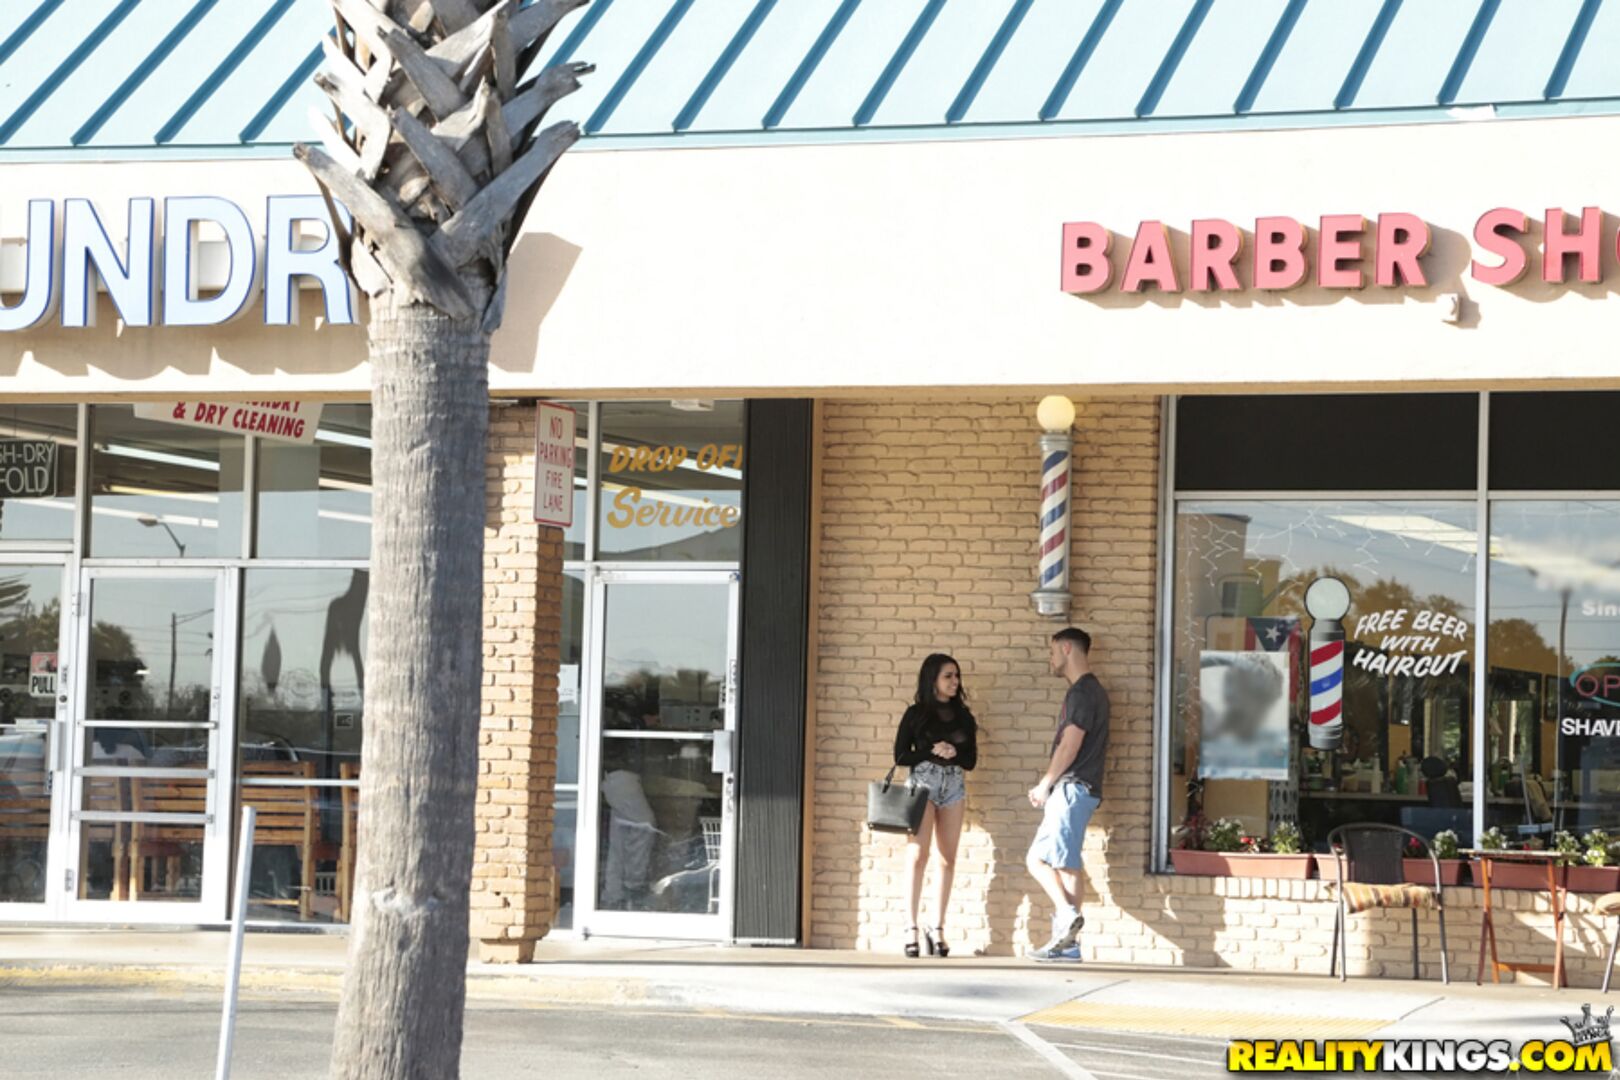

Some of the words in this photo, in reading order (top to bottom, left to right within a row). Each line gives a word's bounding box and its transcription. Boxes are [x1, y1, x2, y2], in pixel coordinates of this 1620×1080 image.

[1060, 211, 1431, 292] BARBER
[1470, 206, 1620, 285] SH
[172, 401, 186, 419] &
[194, 402, 229, 426] DRY
[232, 408, 305, 438] CLEANING
[549, 415, 563, 439] NO
[0, 443, 55, 464] H-DRY
[539, 440, 574, 469] PARKING
[607, 444, 688, 473] DROP
[545, 469, 563, 489] FIRE
[543, 492, 563, 513] LANE
[606, 486, 741, 529] Service
[1582, 600, 1620, 617] Sin
[1353, 608, 1408, 640] FREE
[1411, 610, 1468, 642] BEER
[1380, 634, 1440, 652] WITH
[1352, 649, 1468, 678] HAIRCUT
[31, 674, 56, 694] PULL
